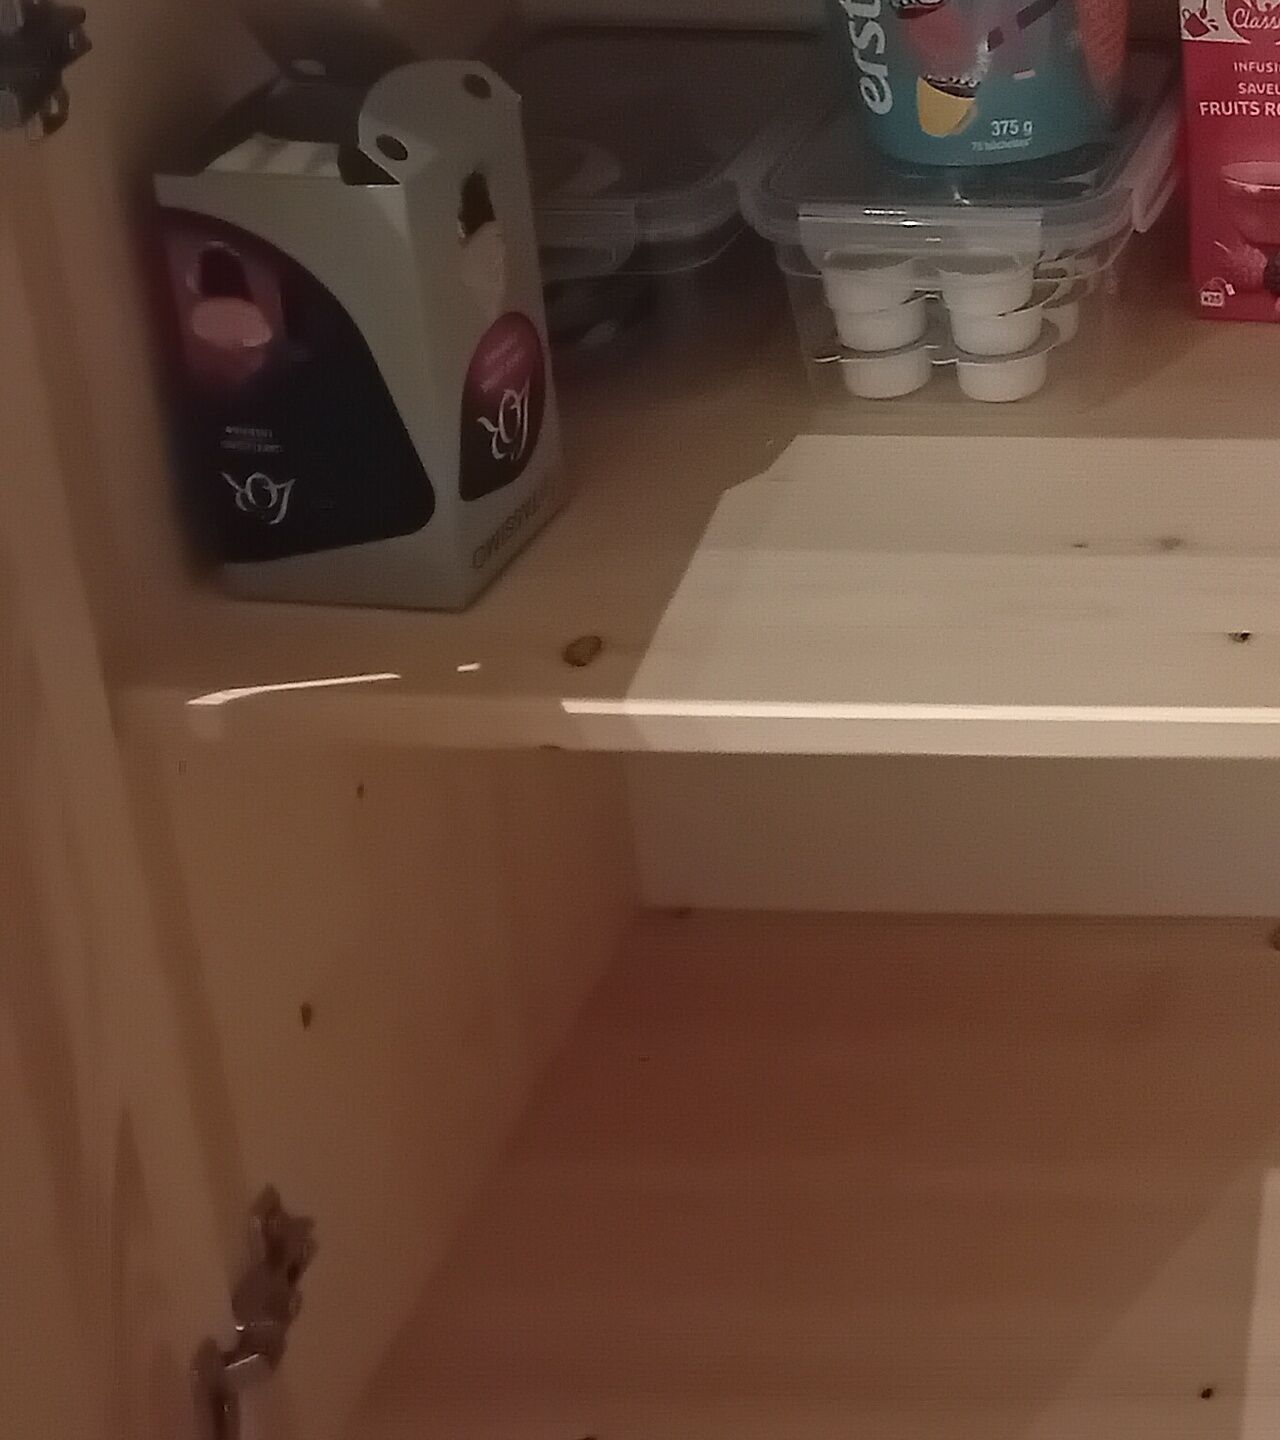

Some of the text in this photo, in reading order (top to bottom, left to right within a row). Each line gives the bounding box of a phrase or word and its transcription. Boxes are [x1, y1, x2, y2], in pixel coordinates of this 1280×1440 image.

[1200, 101, 1261, 117] FRUITS
[991, 120, 1033, 136] 375 g
